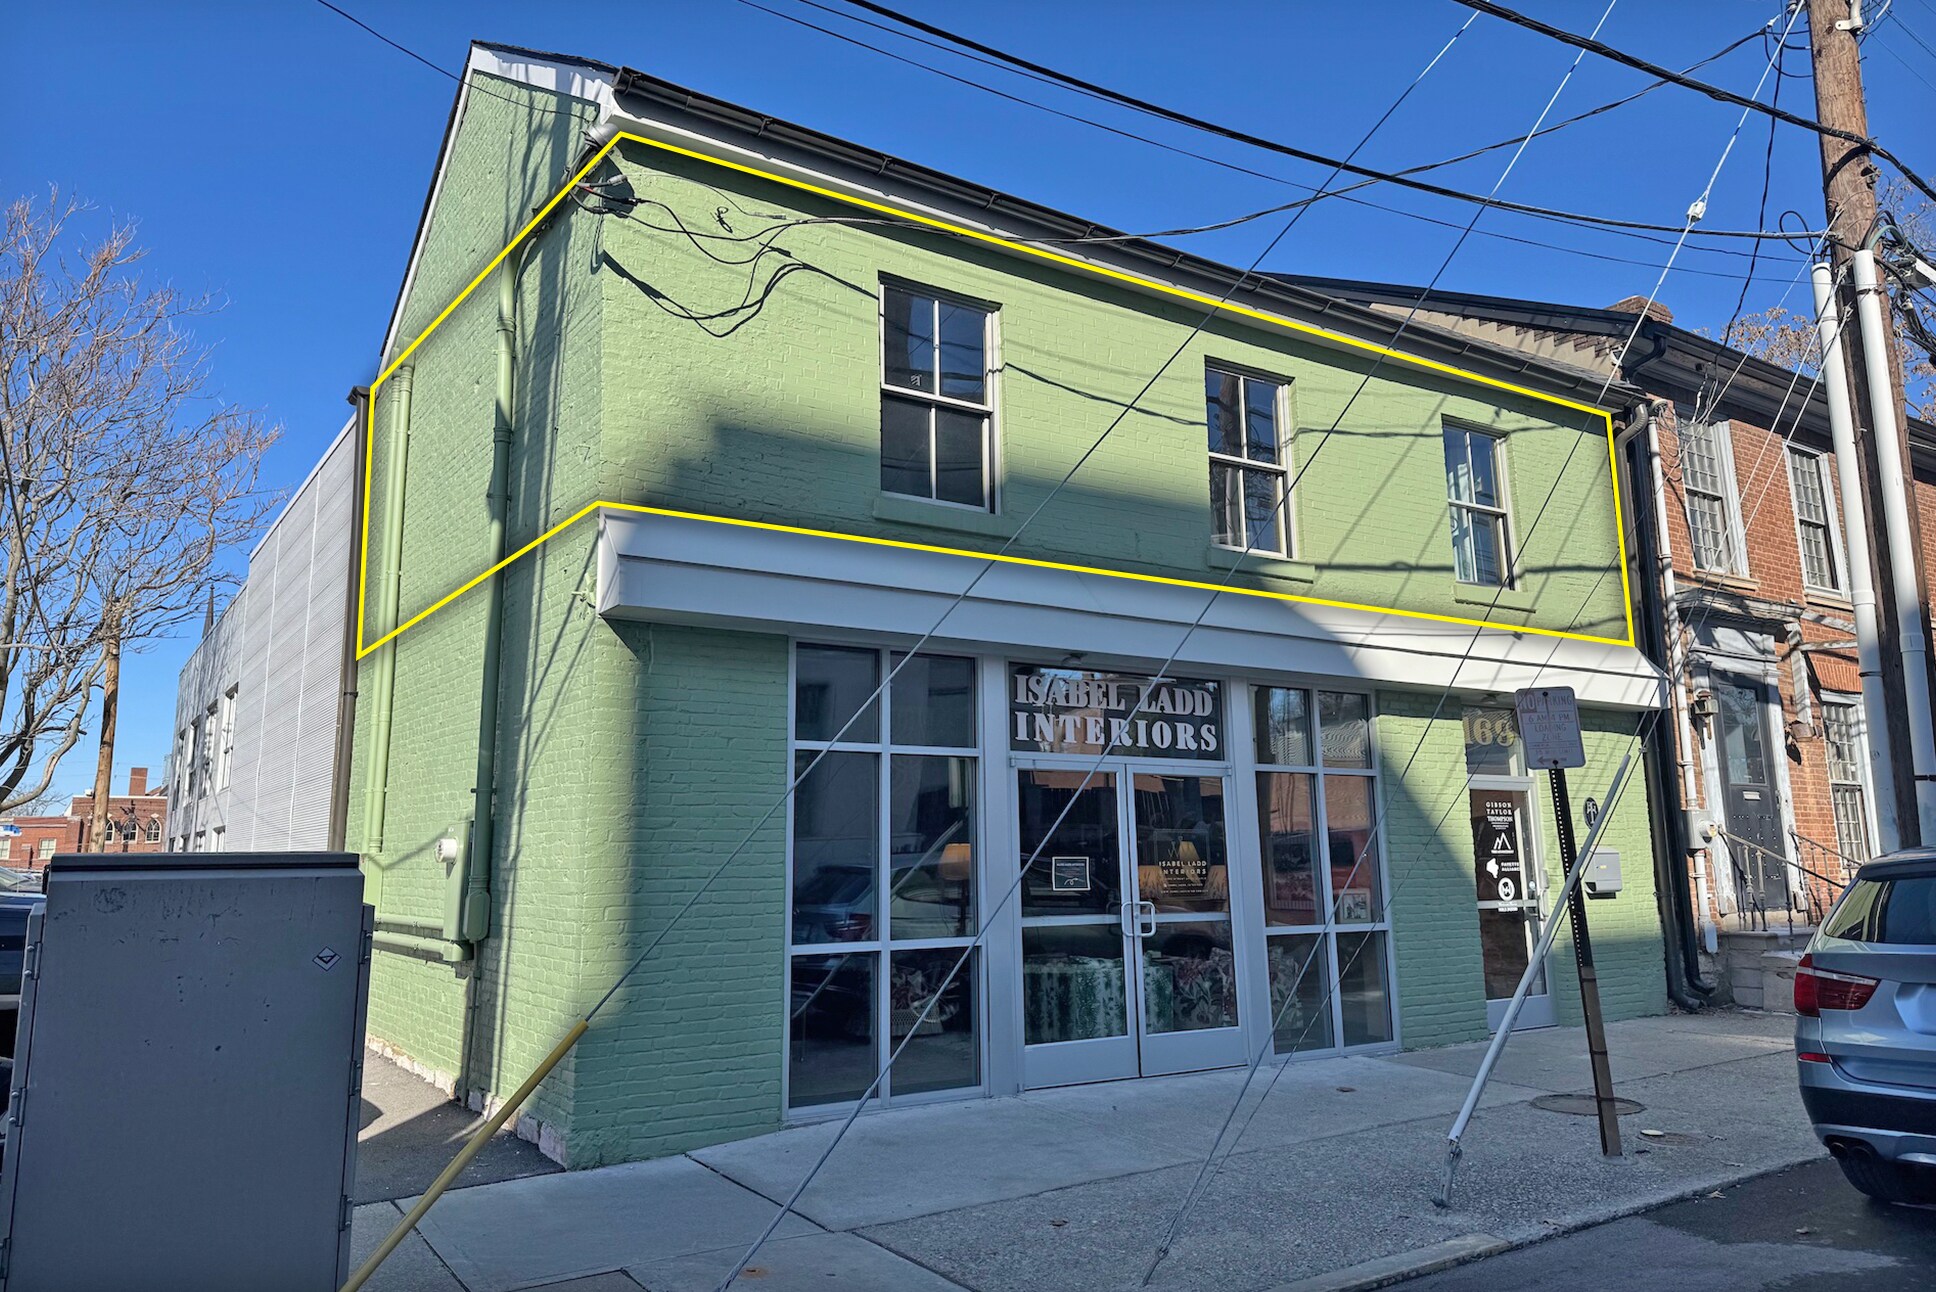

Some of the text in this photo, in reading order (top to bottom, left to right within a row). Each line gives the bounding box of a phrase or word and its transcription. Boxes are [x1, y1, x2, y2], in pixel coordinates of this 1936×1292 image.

[1014, 674, 1213, 717] ISABEL LADD
[1014, 711, 1218, 752] INTERIORS
[1558, 713, 1570, 721] PM
